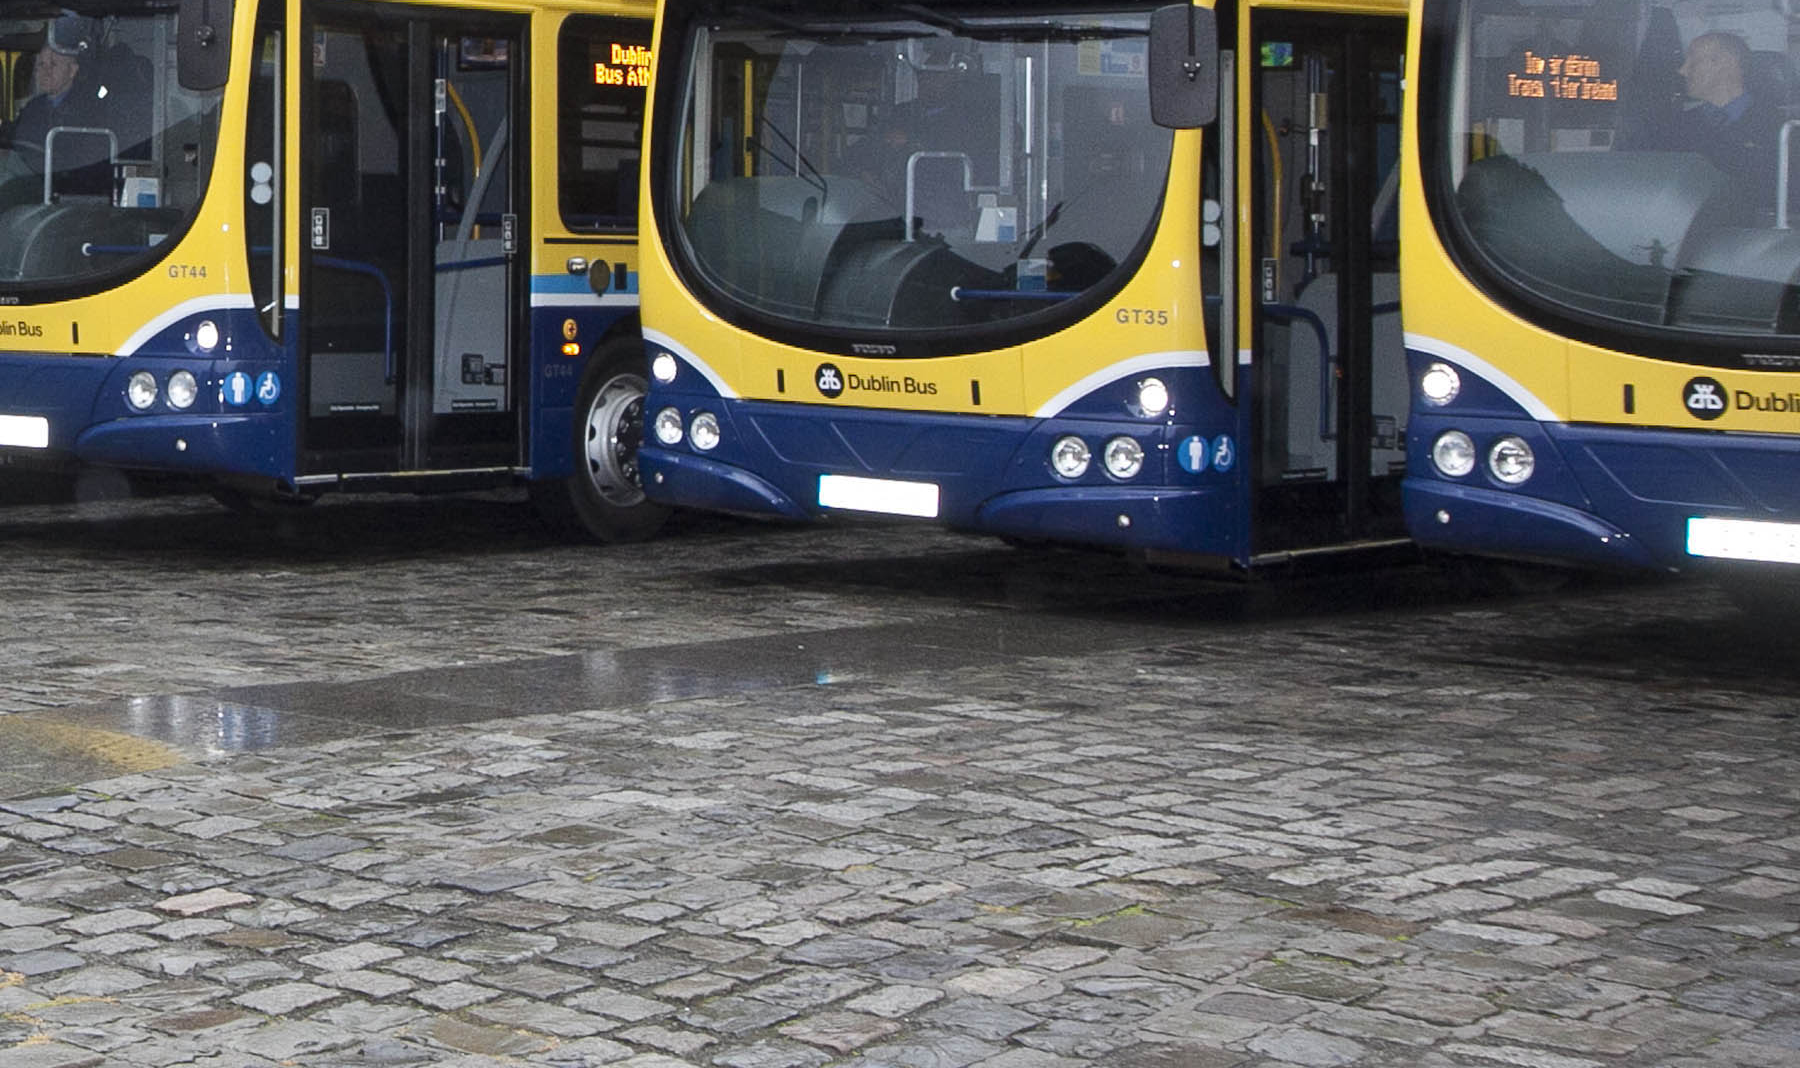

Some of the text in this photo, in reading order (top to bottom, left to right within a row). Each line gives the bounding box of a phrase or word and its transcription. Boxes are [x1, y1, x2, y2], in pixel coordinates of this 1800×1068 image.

[595, 63, 624, 85] Bus
[168, 265, 207, 278] GT44
[1116, 308, 1168, 326] GT35
[18, 321, 43, 337] Bus
[848, 374, 938, 395] Dublin Bus
[1734, 389, 1800, 413] Dubli
